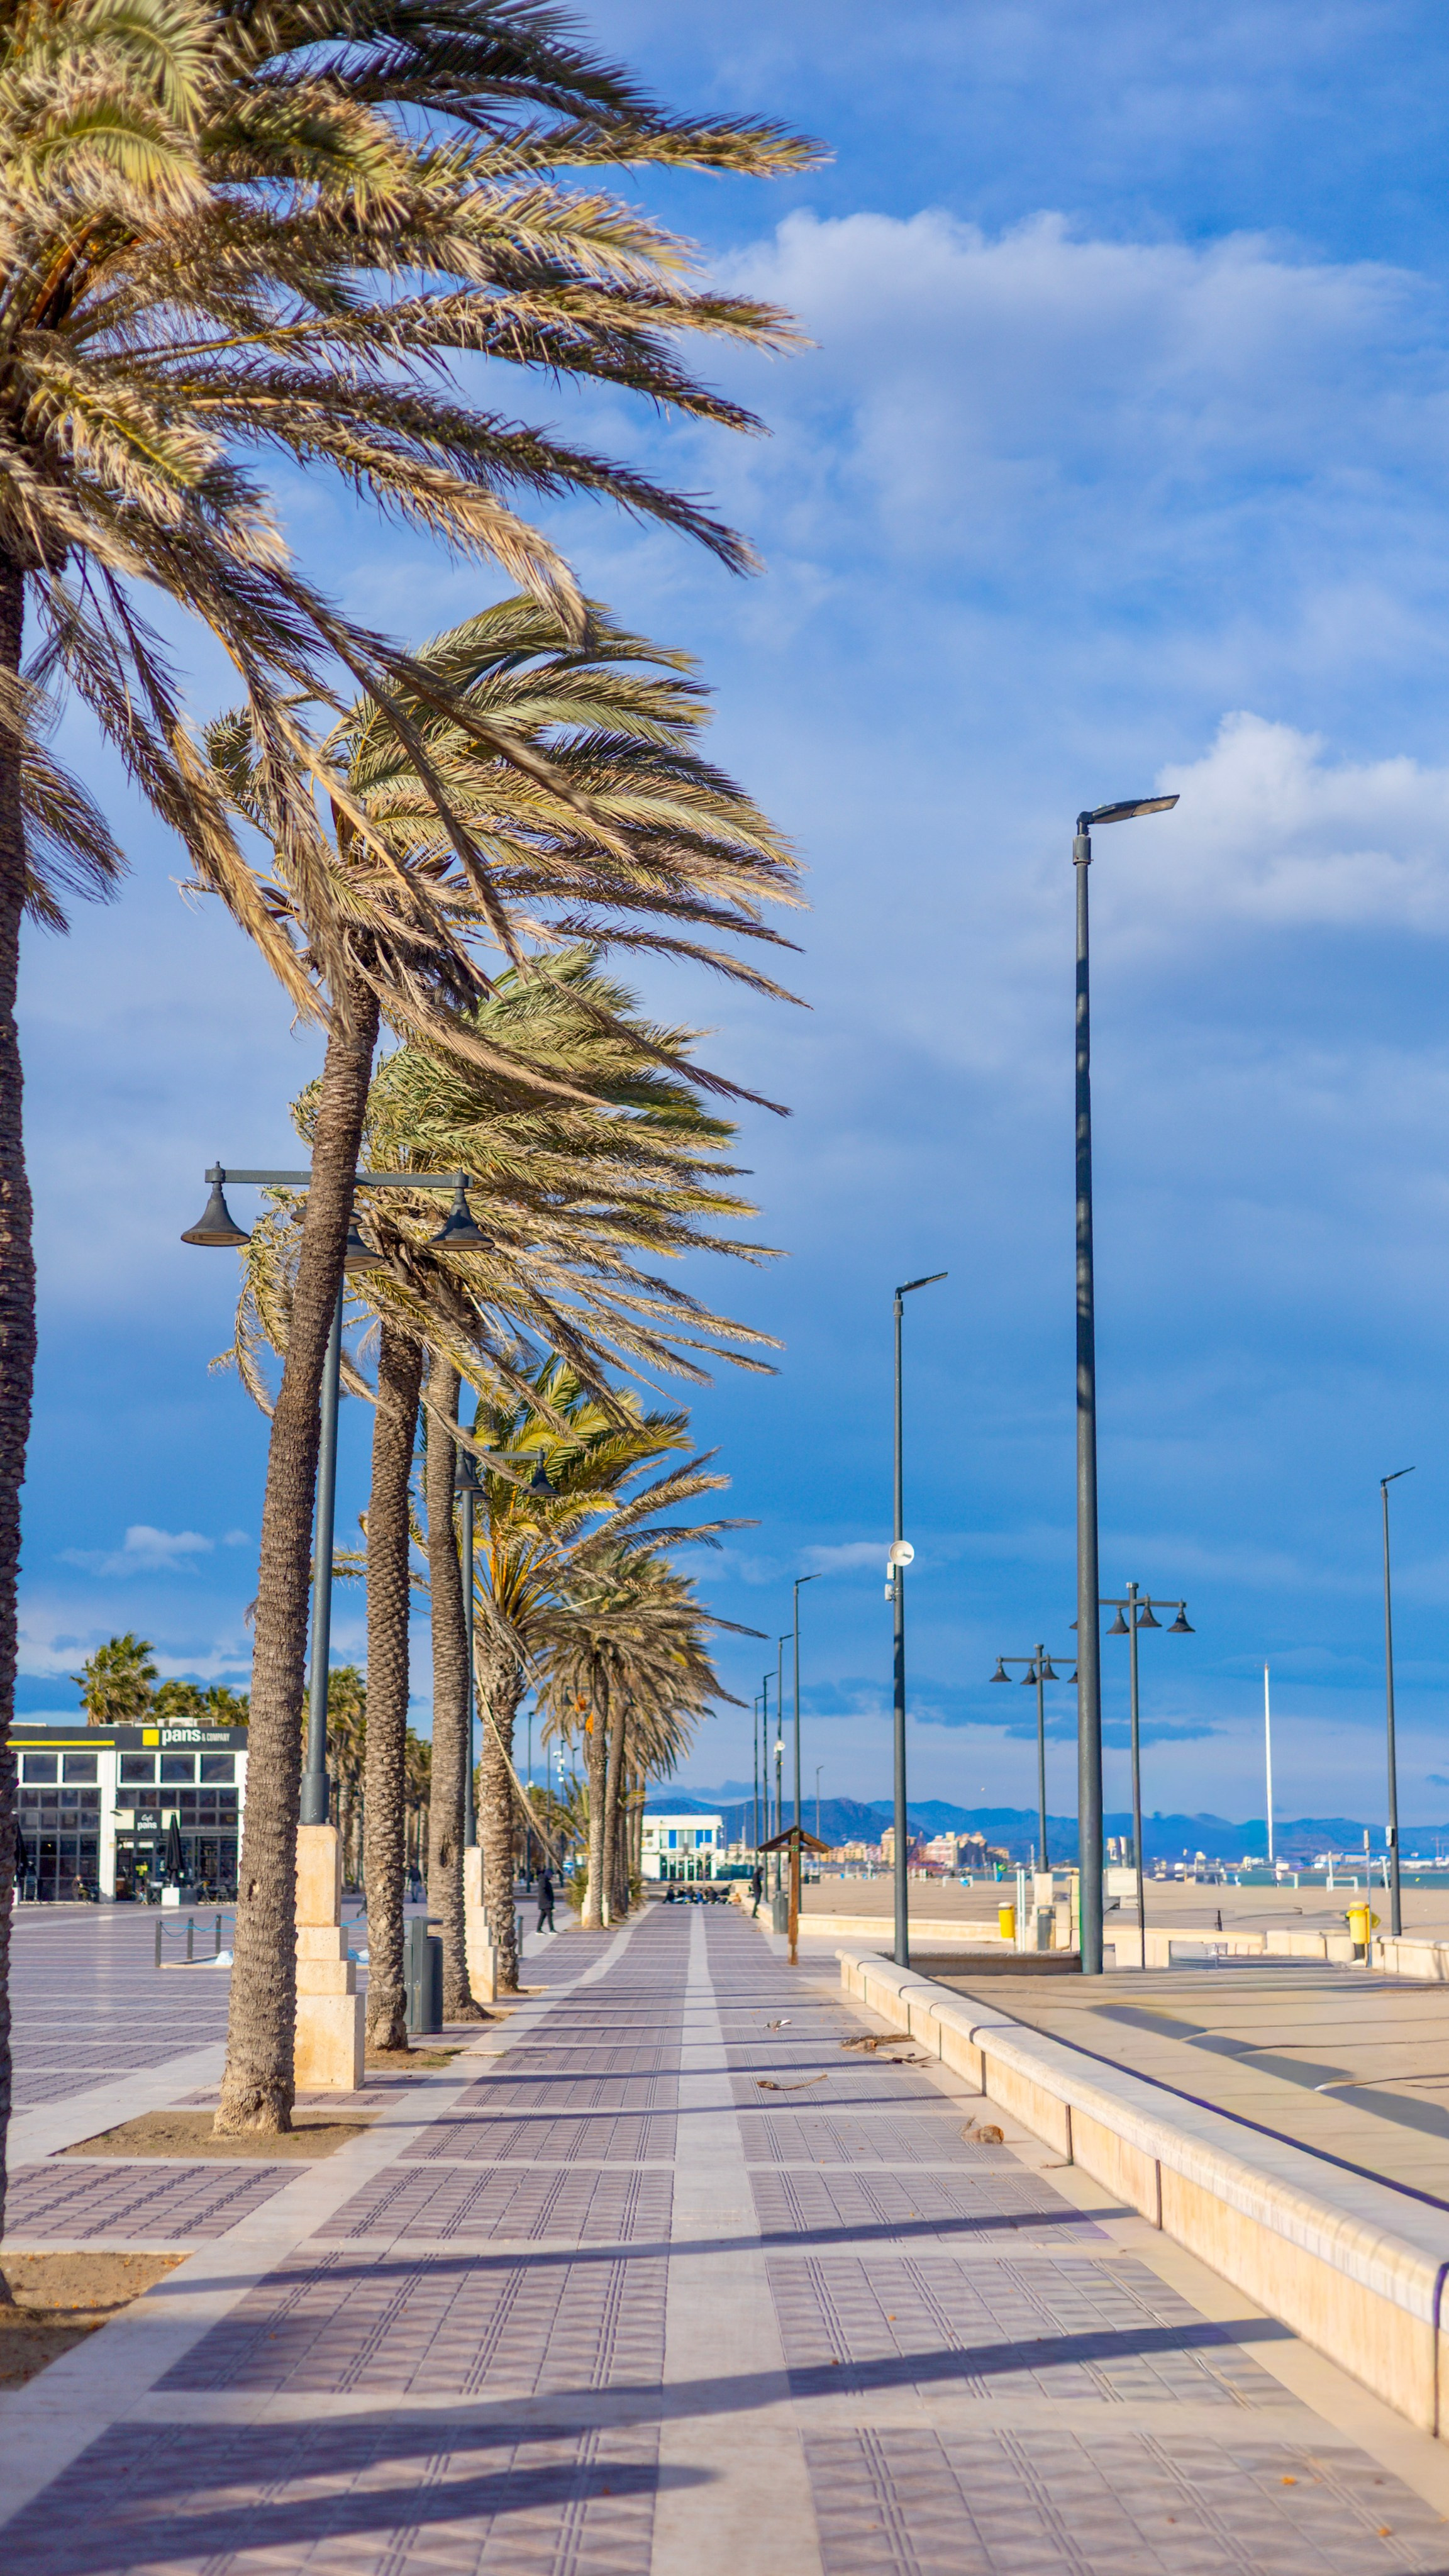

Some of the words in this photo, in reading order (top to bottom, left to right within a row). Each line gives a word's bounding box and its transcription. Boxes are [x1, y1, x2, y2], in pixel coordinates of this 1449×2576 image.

[162, 1729, 201, 1746] pans
[206, 1733, 230, 1742] COMPANY
[137, 1822, 157, 1831] pans
